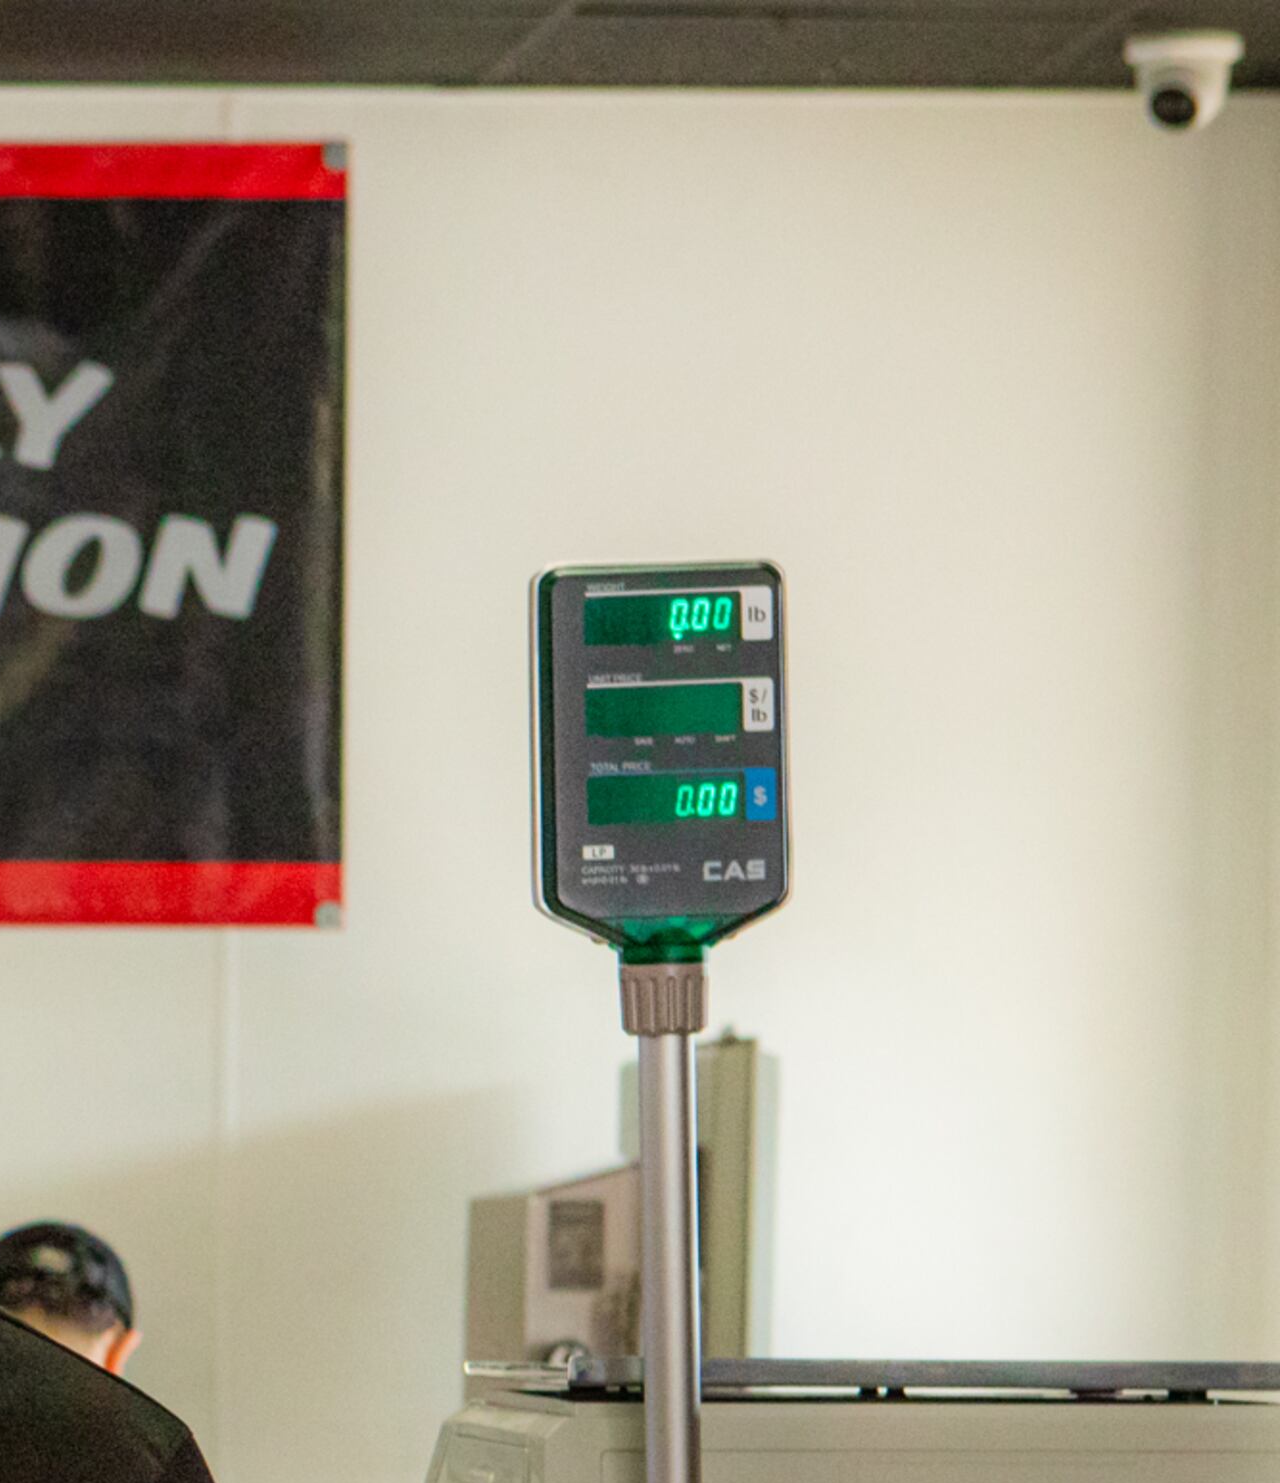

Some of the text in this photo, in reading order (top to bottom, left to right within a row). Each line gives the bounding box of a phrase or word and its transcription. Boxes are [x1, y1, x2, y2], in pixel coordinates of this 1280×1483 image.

[747, 606, 766, 624] lb
[751, 708, 768, 724] lb
[675, 782, 738, 818] 0.00
[753, 786, 768, 806] $
[702, 859, 766, 881] CAS
